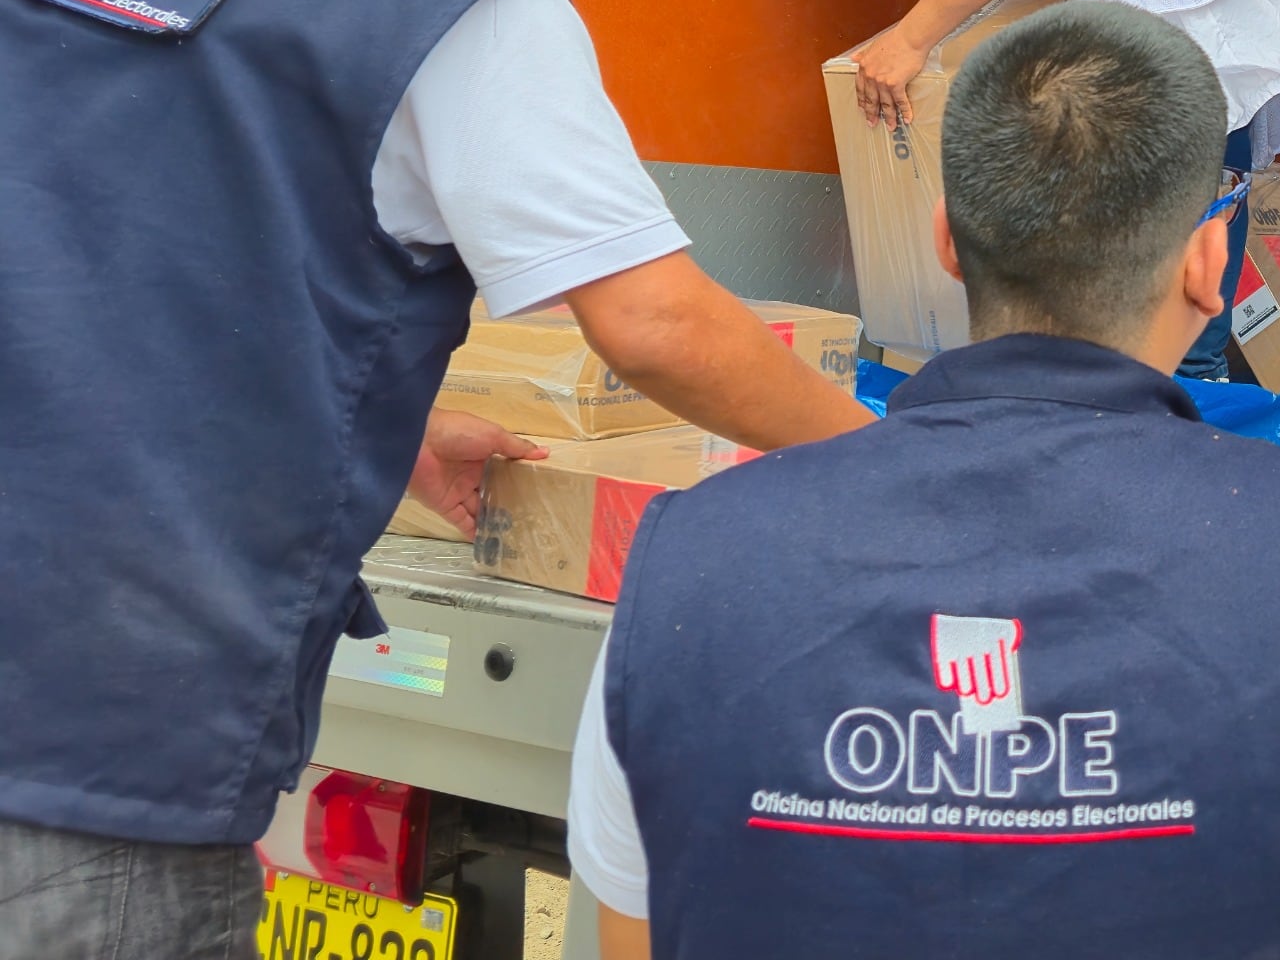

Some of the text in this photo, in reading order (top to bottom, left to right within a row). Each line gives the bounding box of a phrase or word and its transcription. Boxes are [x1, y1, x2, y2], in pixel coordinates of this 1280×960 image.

[441, 382, 491, 396] ECTORALES
[375, 643, 391, 656] 3M
[824, 707, 1118, 798] ONPE
[750, 789, 1195, 829] Oficina Nacional de Procesos Electorales
[307, 880, 381, 920] PERU
